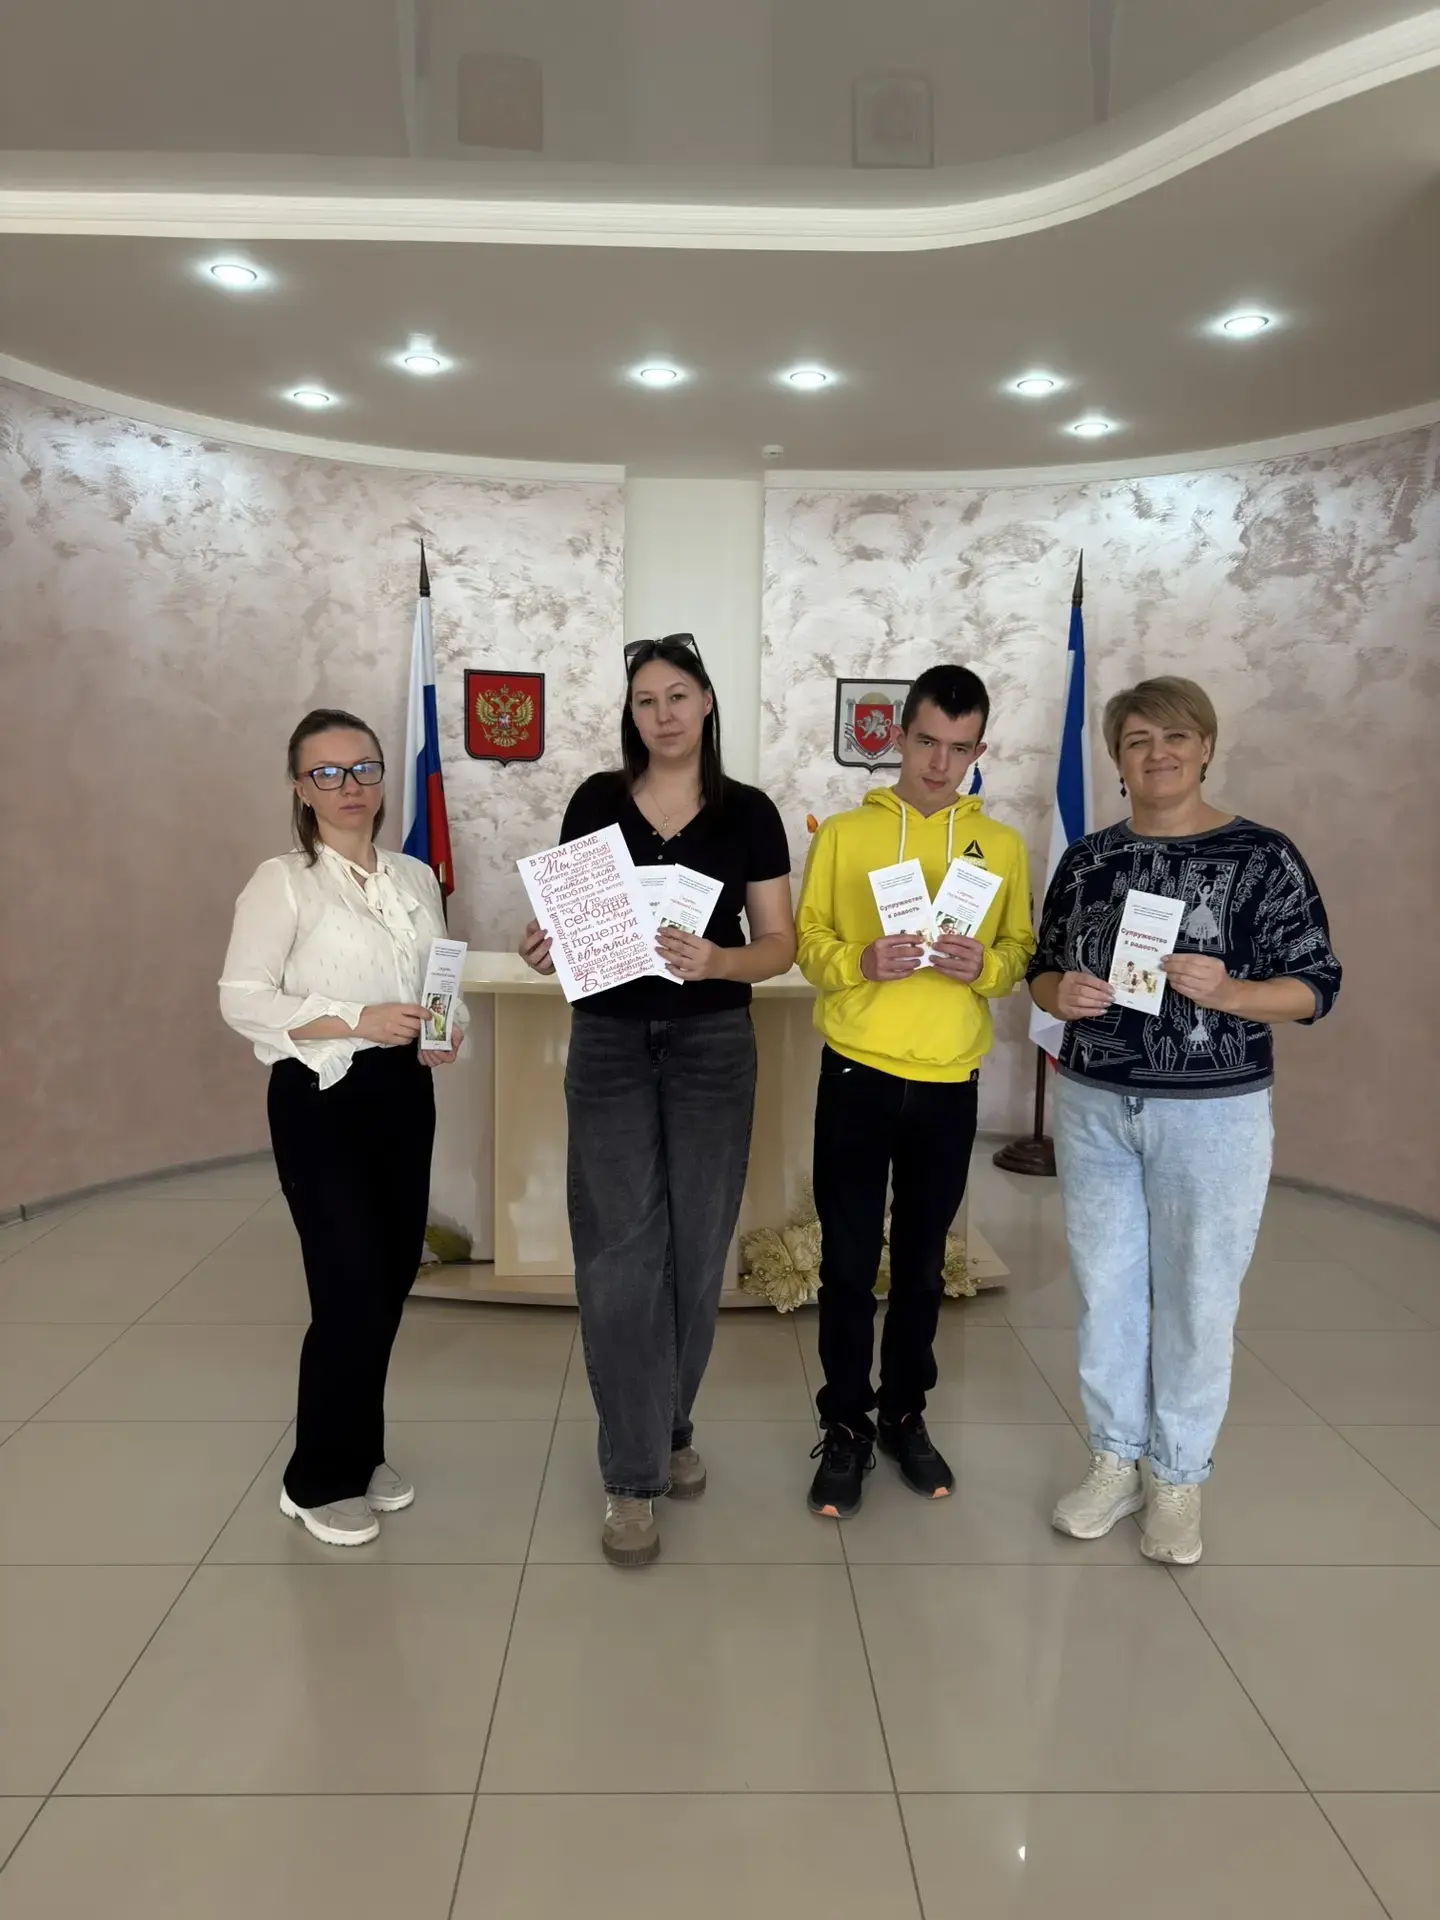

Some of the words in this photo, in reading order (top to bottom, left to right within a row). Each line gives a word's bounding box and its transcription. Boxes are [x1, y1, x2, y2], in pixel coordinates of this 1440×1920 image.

[531, 854, 572, 881] Мы
[572, 841, 610, 861] Семья!
[537, 847, 567, 863] ЭТОМ
[537, 871, 569, 886] Любите
[570, 863, 588, 875] друг
[590, 854, 613, 867] друга
[540, 871, 588, 898] Смейтесь
[543, 896, 553, 906] Я
[555, 883, 593, 902] люблю
[594, 872, 620, 886] тебя
[556, 897, 580, 909] бросай
[580, 891, 596, 900] слов
[879, 895, 923, 911] Супружество
[564, 896, 630, 928] сегодня
[893, 906, 920, 917] радость
[570, 916, 638, 948] поцелуи
[577, 931, 642, 962] объятия
[1121, 927, 1167, 944] Супружество
[1129, 941, 1158, 952] радость
[570, 954, 609, 975] прощай
[609, 941, 647, 961] быстро,
